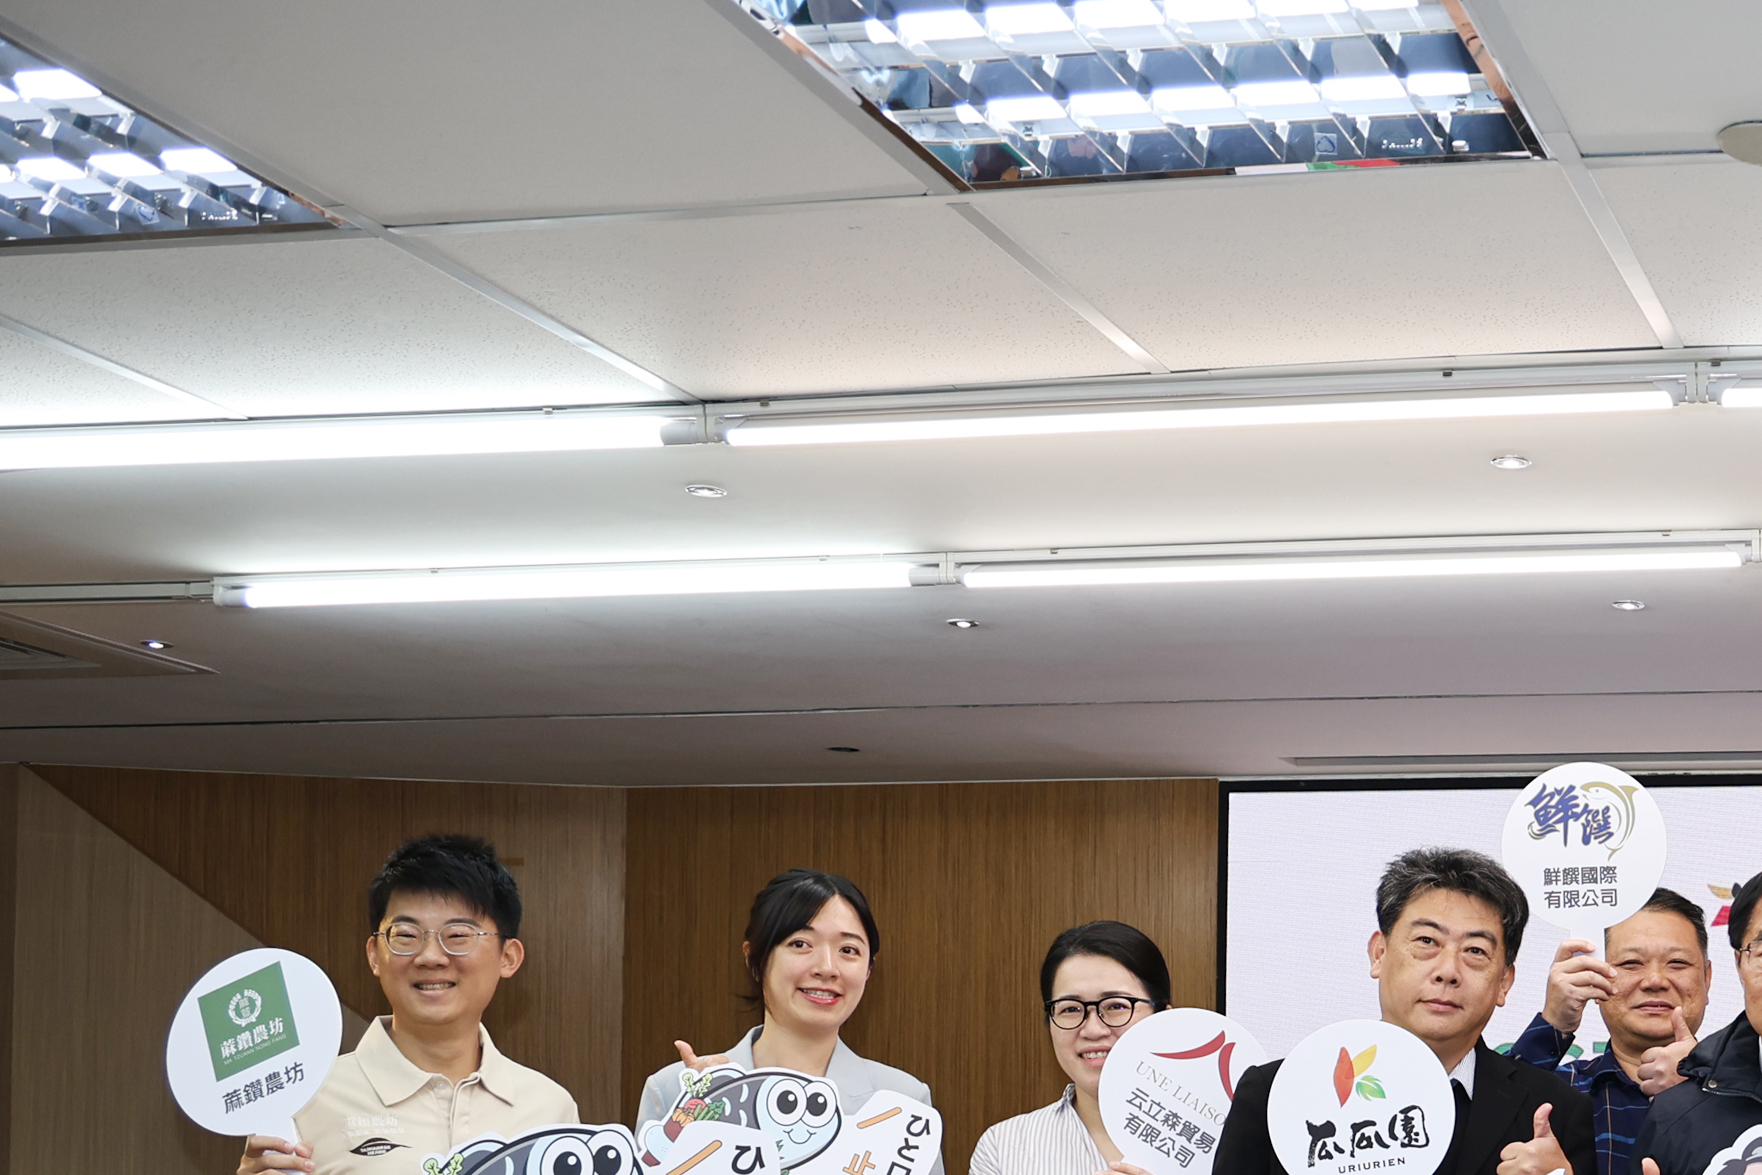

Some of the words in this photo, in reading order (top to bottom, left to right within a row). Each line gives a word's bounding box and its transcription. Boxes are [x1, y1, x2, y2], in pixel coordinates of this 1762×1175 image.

[1544, 888, 1618, 910] 有限公司
[1125, 1087, 1216, 1155] 云立森貿易
[1136, 1061, 1173, 1092] UNE
[1172, 1086, 1227, 1126] LIAISO
[1124, 1112, 1196, 1169] 有限公司
[1338, 1157, 1407, 1174] URIURIEN
